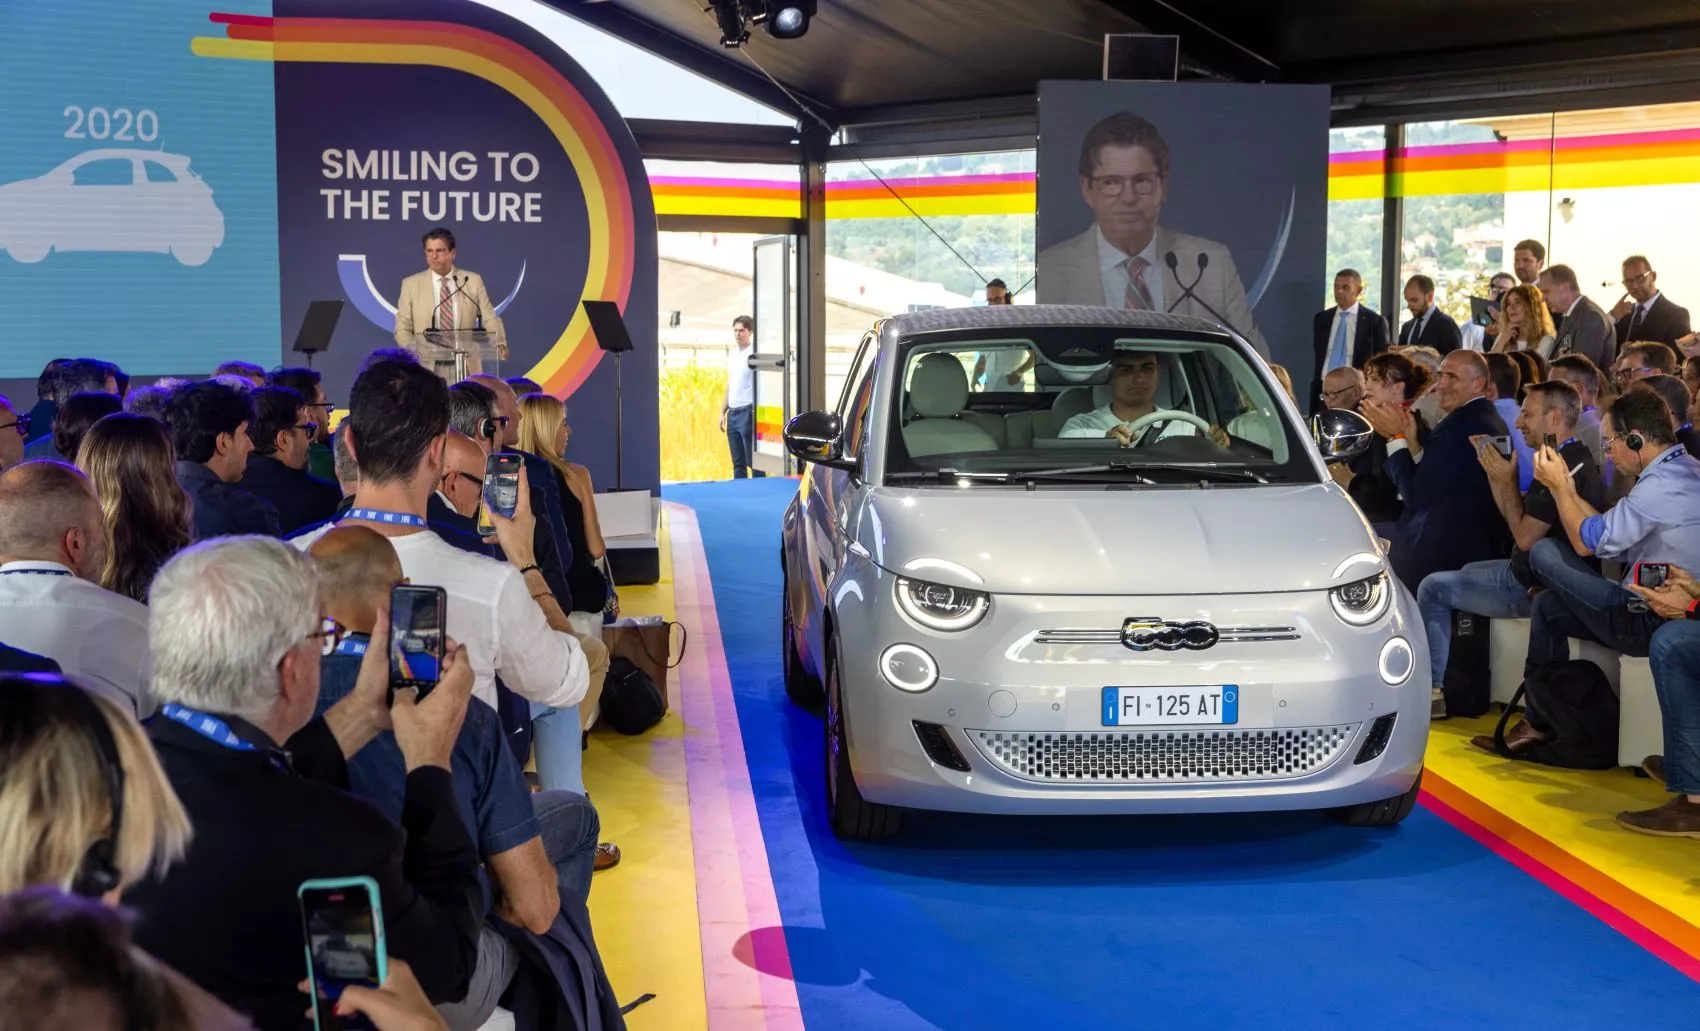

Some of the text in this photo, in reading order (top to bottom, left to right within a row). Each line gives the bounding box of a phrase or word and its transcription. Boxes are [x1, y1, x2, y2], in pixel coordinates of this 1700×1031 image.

[63, 105, 159, 142] 2020
[321, 148, 540, 183] SMILING TO
[319, 188, 542, 223] THE FUTURE
[1122, 693, 1221, 717] FI 125 AT
